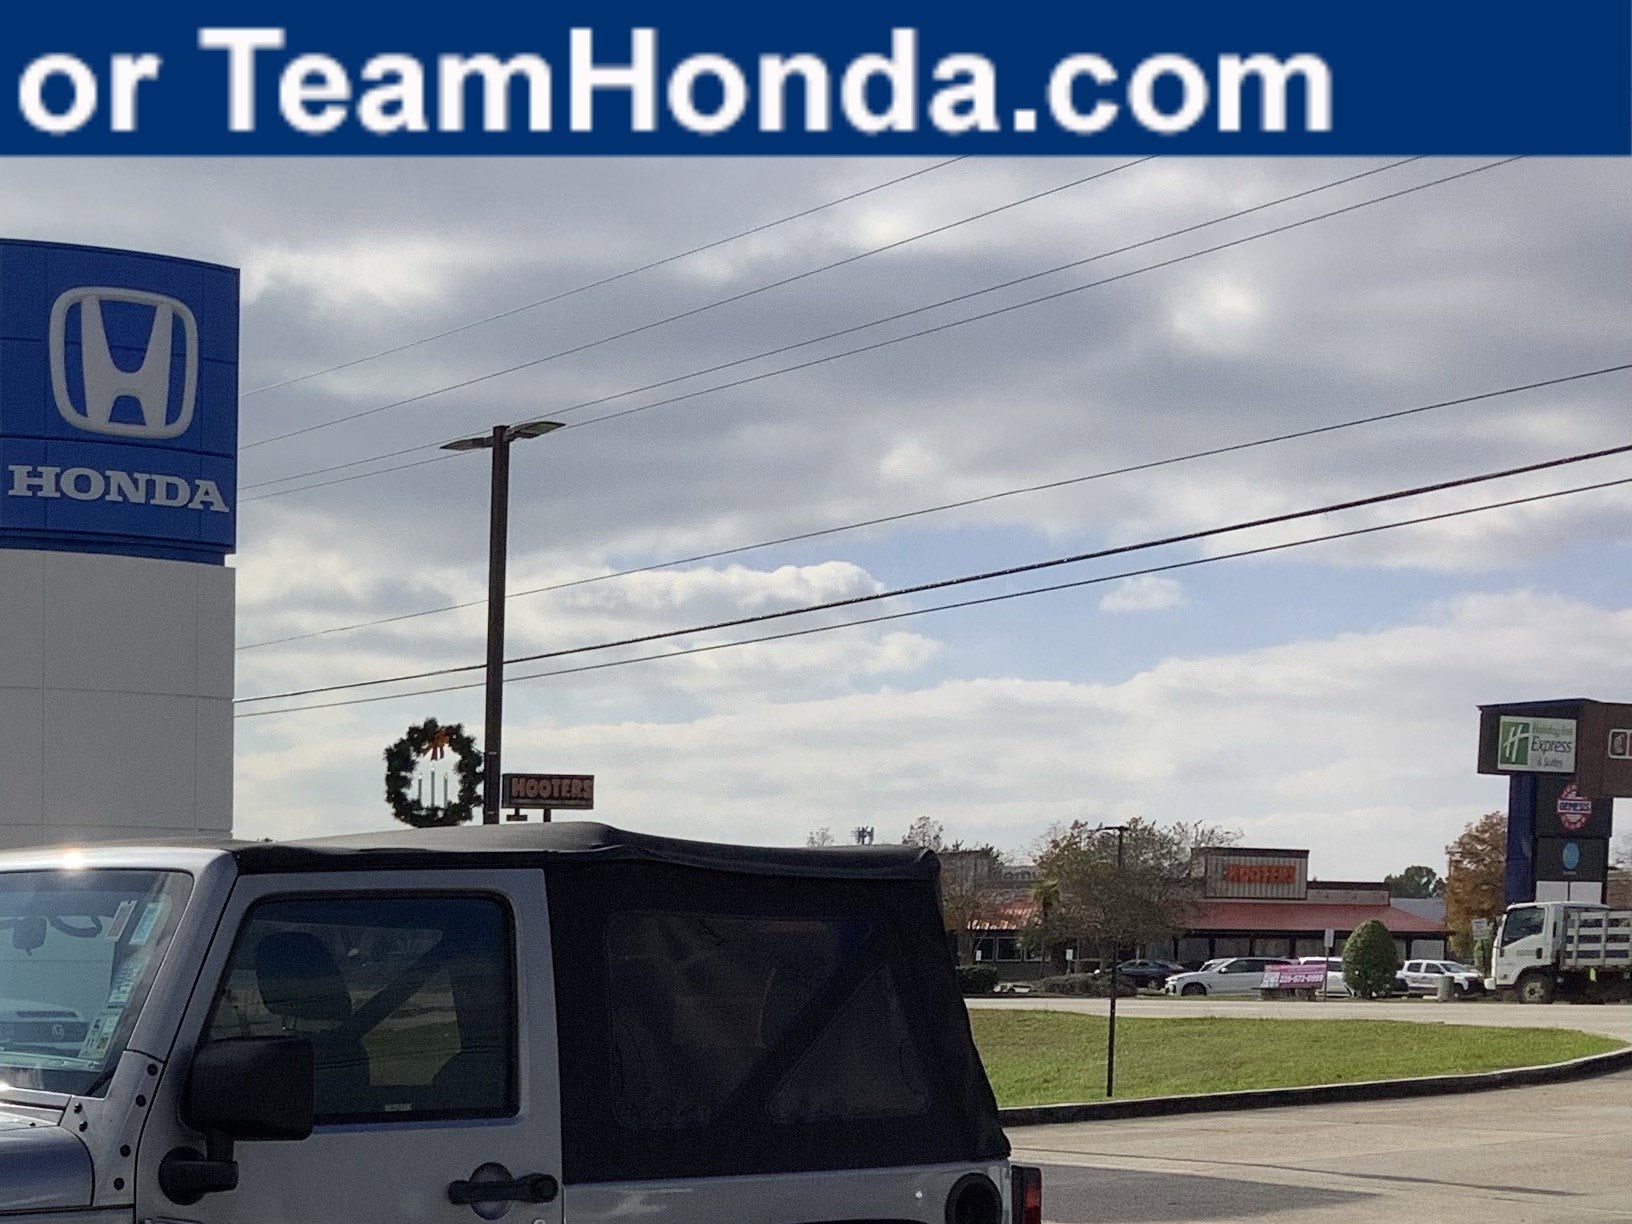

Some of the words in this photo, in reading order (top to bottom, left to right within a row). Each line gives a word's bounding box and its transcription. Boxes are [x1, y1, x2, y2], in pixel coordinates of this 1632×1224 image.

[8, 464, 230, 513] HONDA
[1531, 736, 1573, 753] Express
[510, 777, 593, 799] HOOTERS
